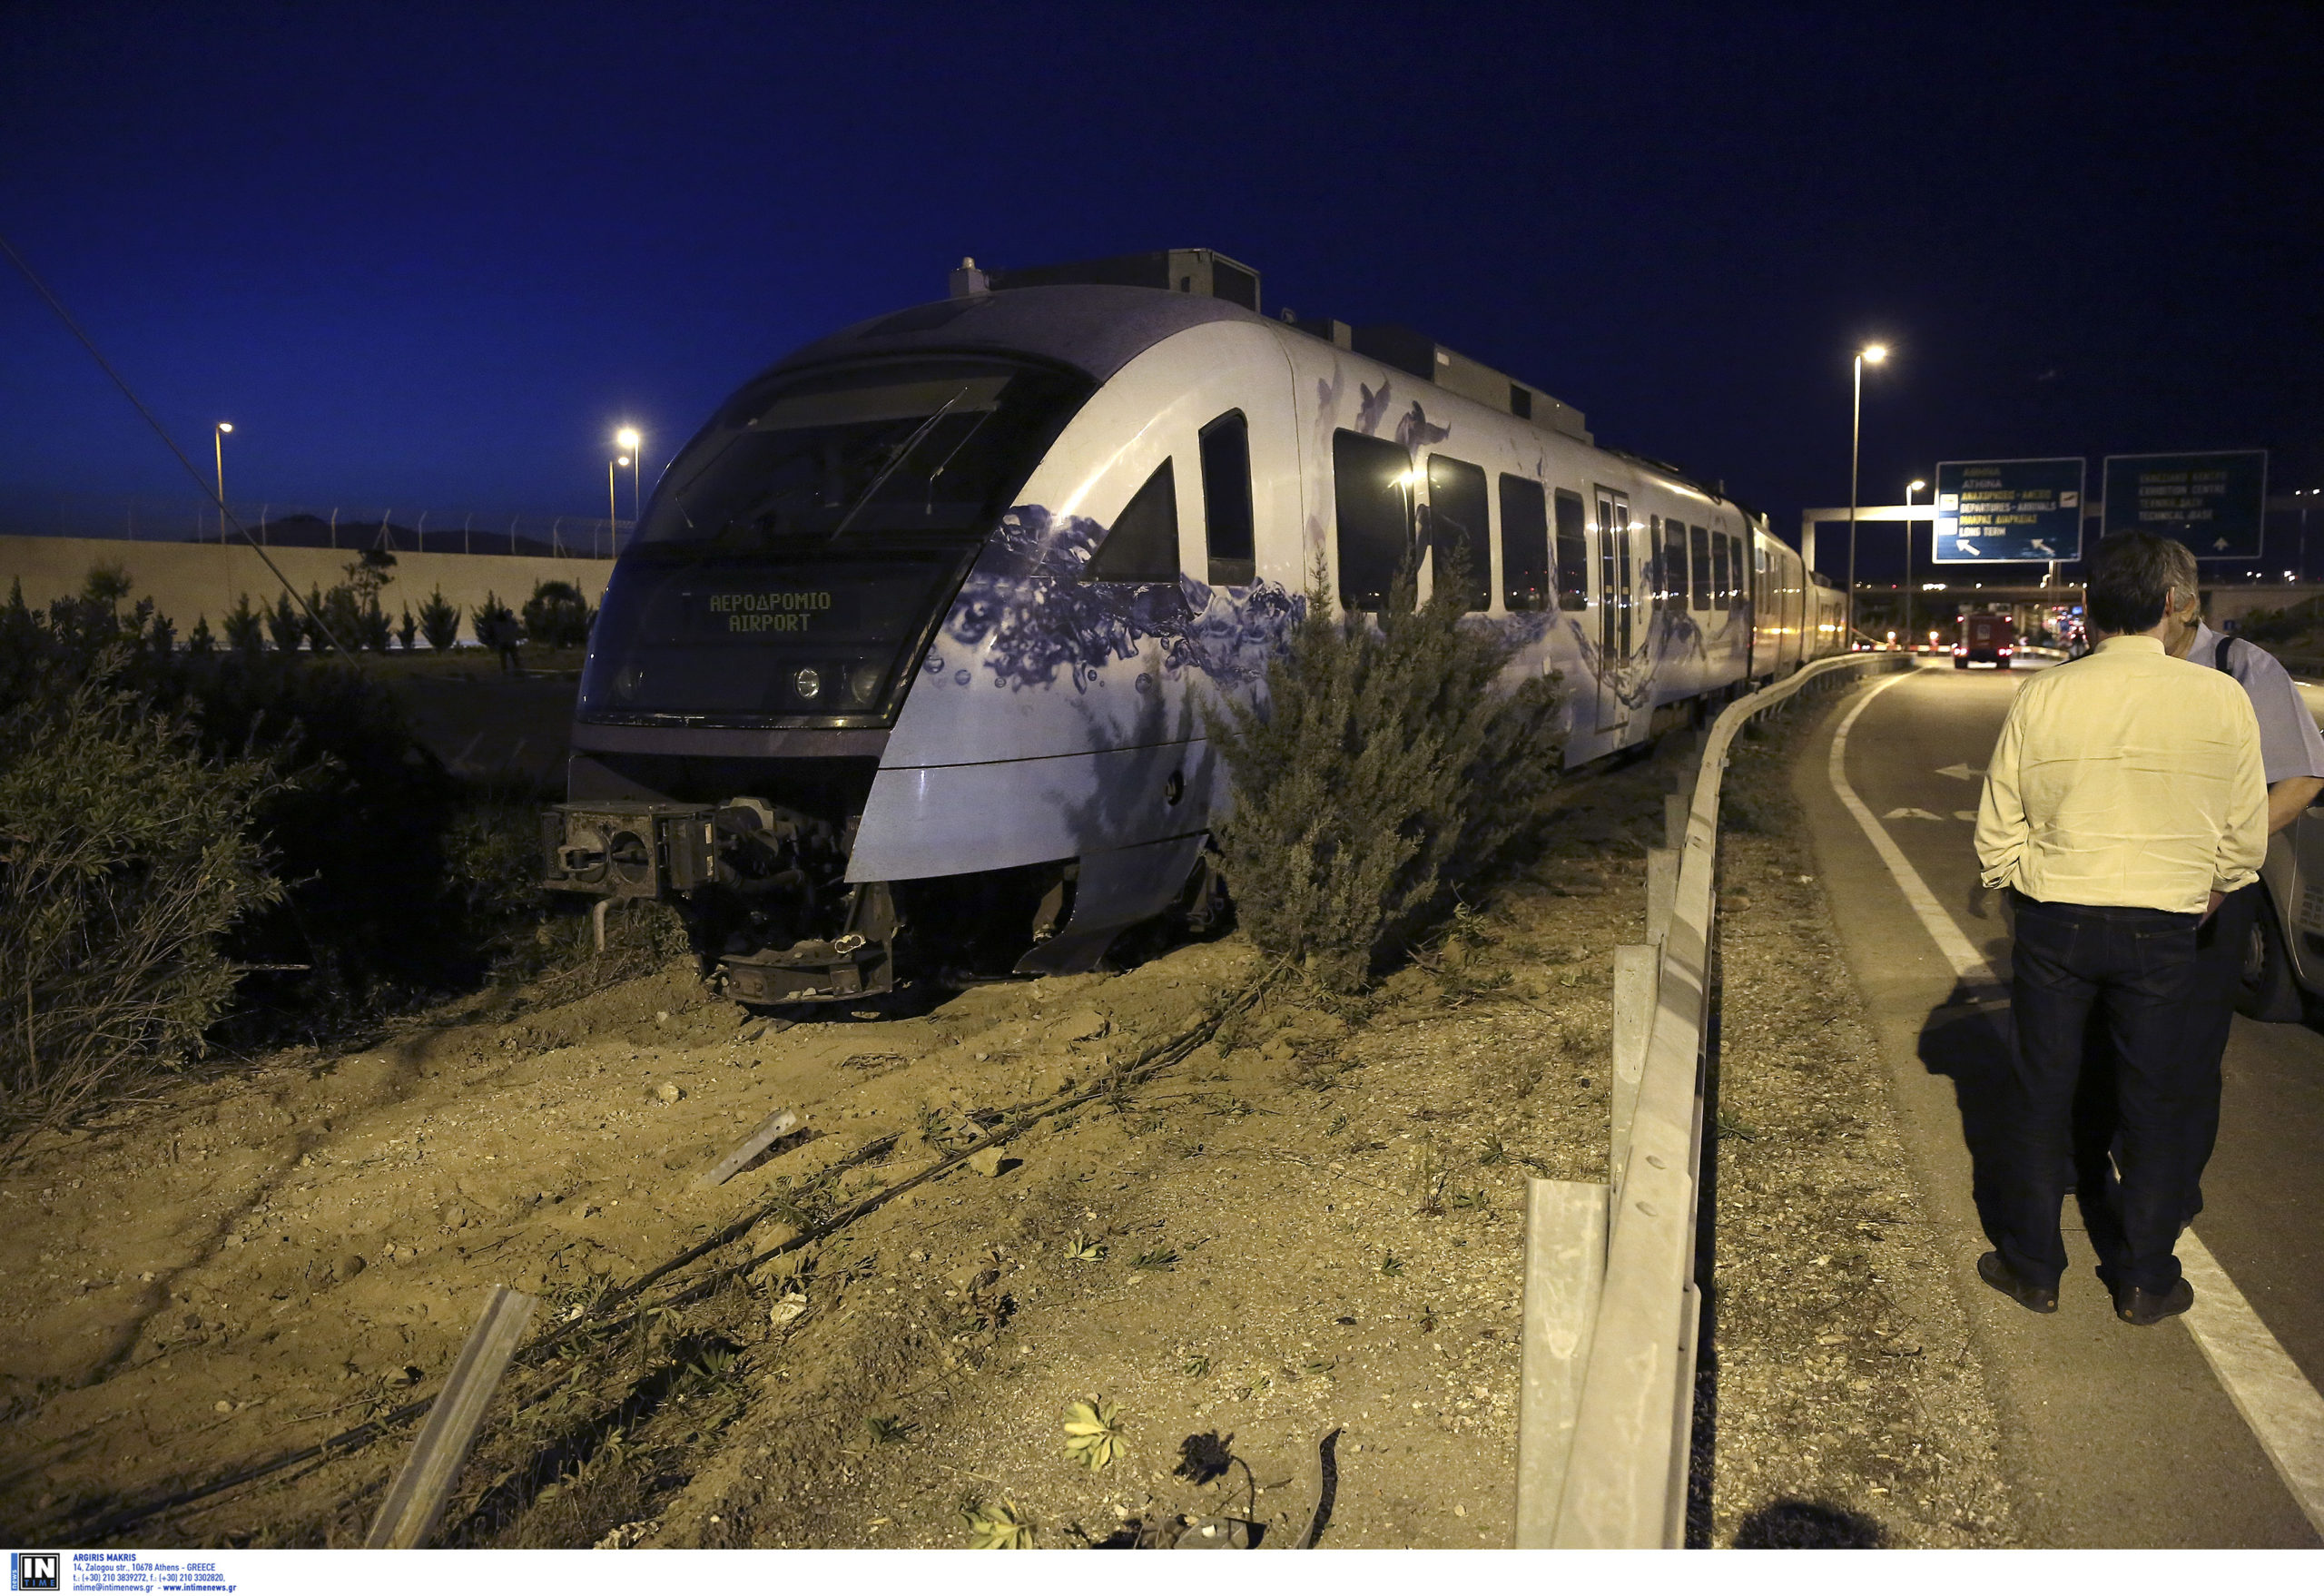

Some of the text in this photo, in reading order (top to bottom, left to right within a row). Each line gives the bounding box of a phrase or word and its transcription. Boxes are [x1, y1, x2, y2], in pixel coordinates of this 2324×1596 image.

[1959, 527, 2006, 537] LONG TERM
[709, 592, 831, 612] ΑΕΡΟΔΡΟΜΙΟ
[729, 613, 811, 633] AIRPORT
